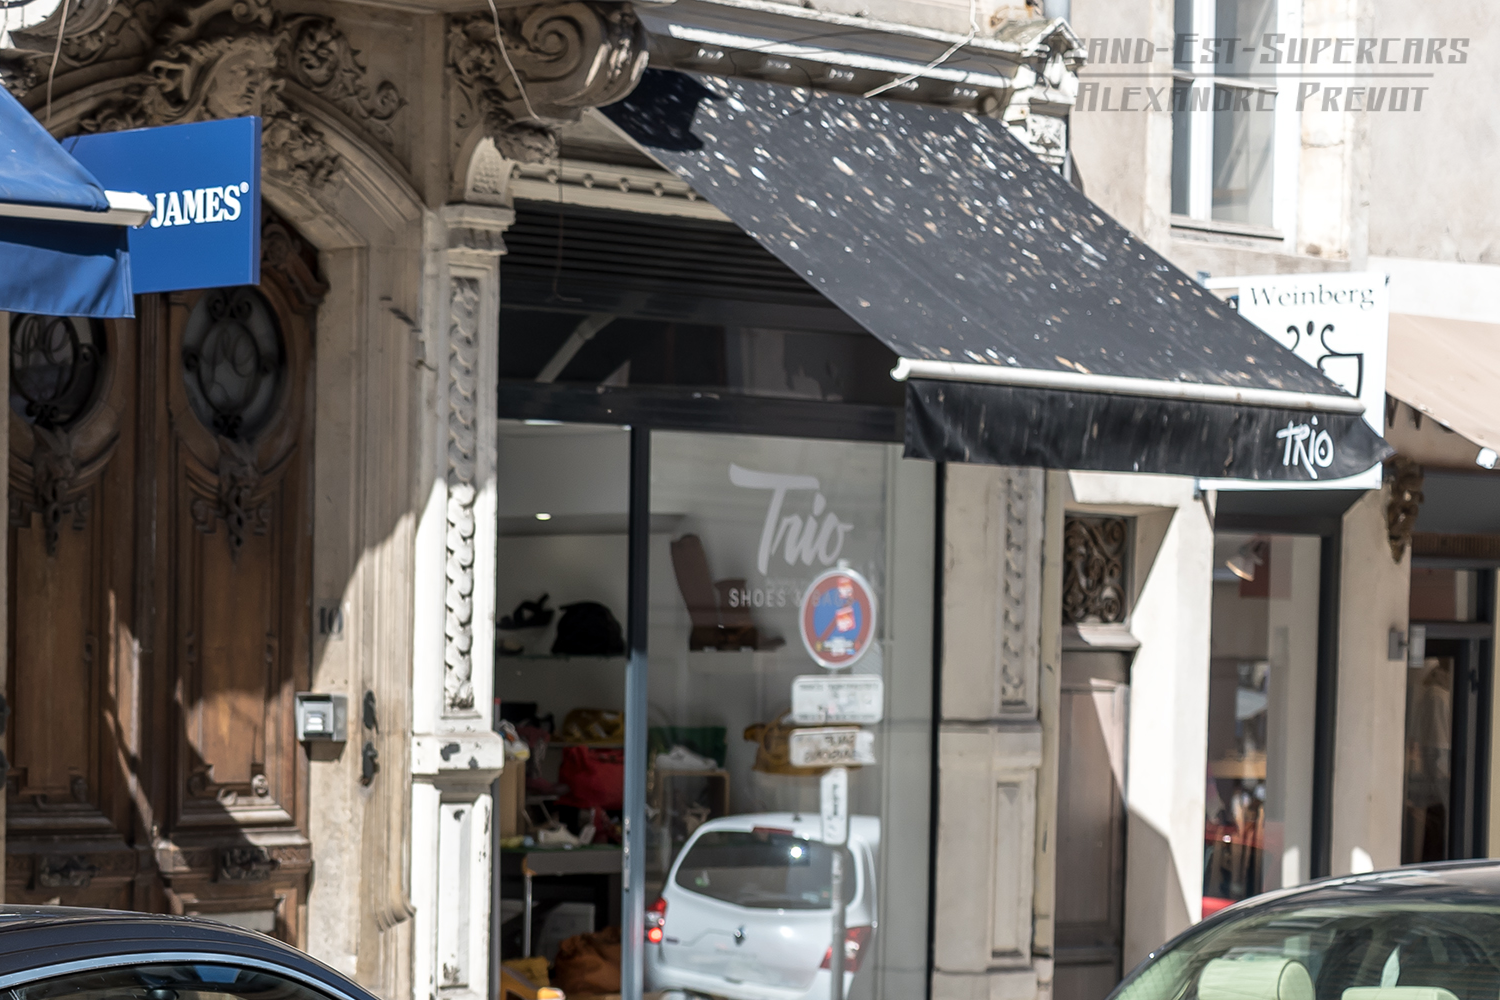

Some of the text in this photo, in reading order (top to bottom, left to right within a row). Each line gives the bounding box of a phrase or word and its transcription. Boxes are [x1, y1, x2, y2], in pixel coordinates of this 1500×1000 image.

[1251, 284, 1375, 311] Weinberg
[729, 463, 855, 576] Trio
[728, 587, 786, 608] SHOES
